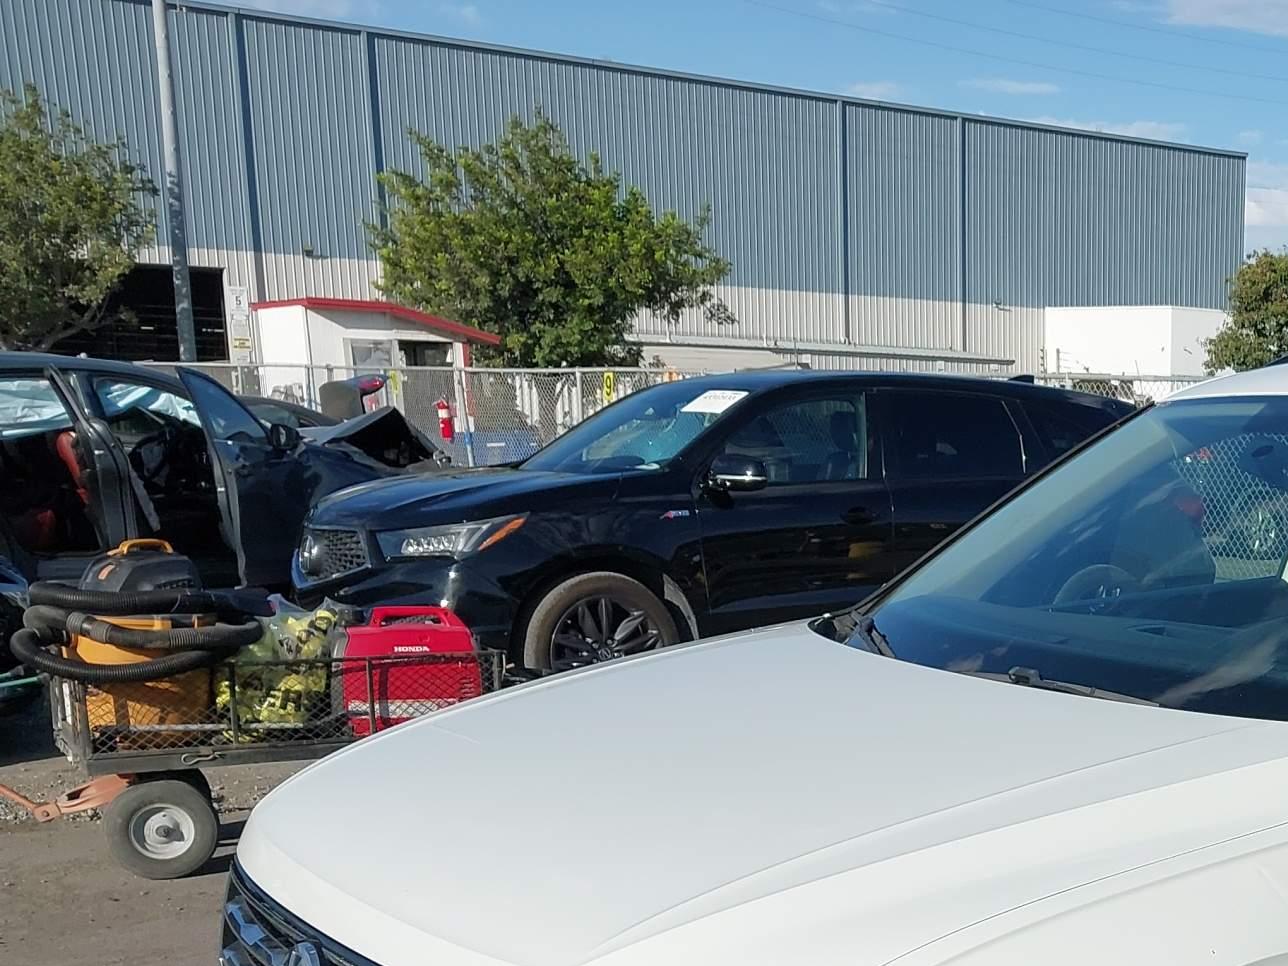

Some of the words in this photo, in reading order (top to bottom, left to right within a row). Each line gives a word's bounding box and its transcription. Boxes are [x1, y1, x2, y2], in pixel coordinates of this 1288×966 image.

[235, 296, 242, 306] 5
[605, 375, 612, 397] 9
[393, 645, 430, 653] HONDA
